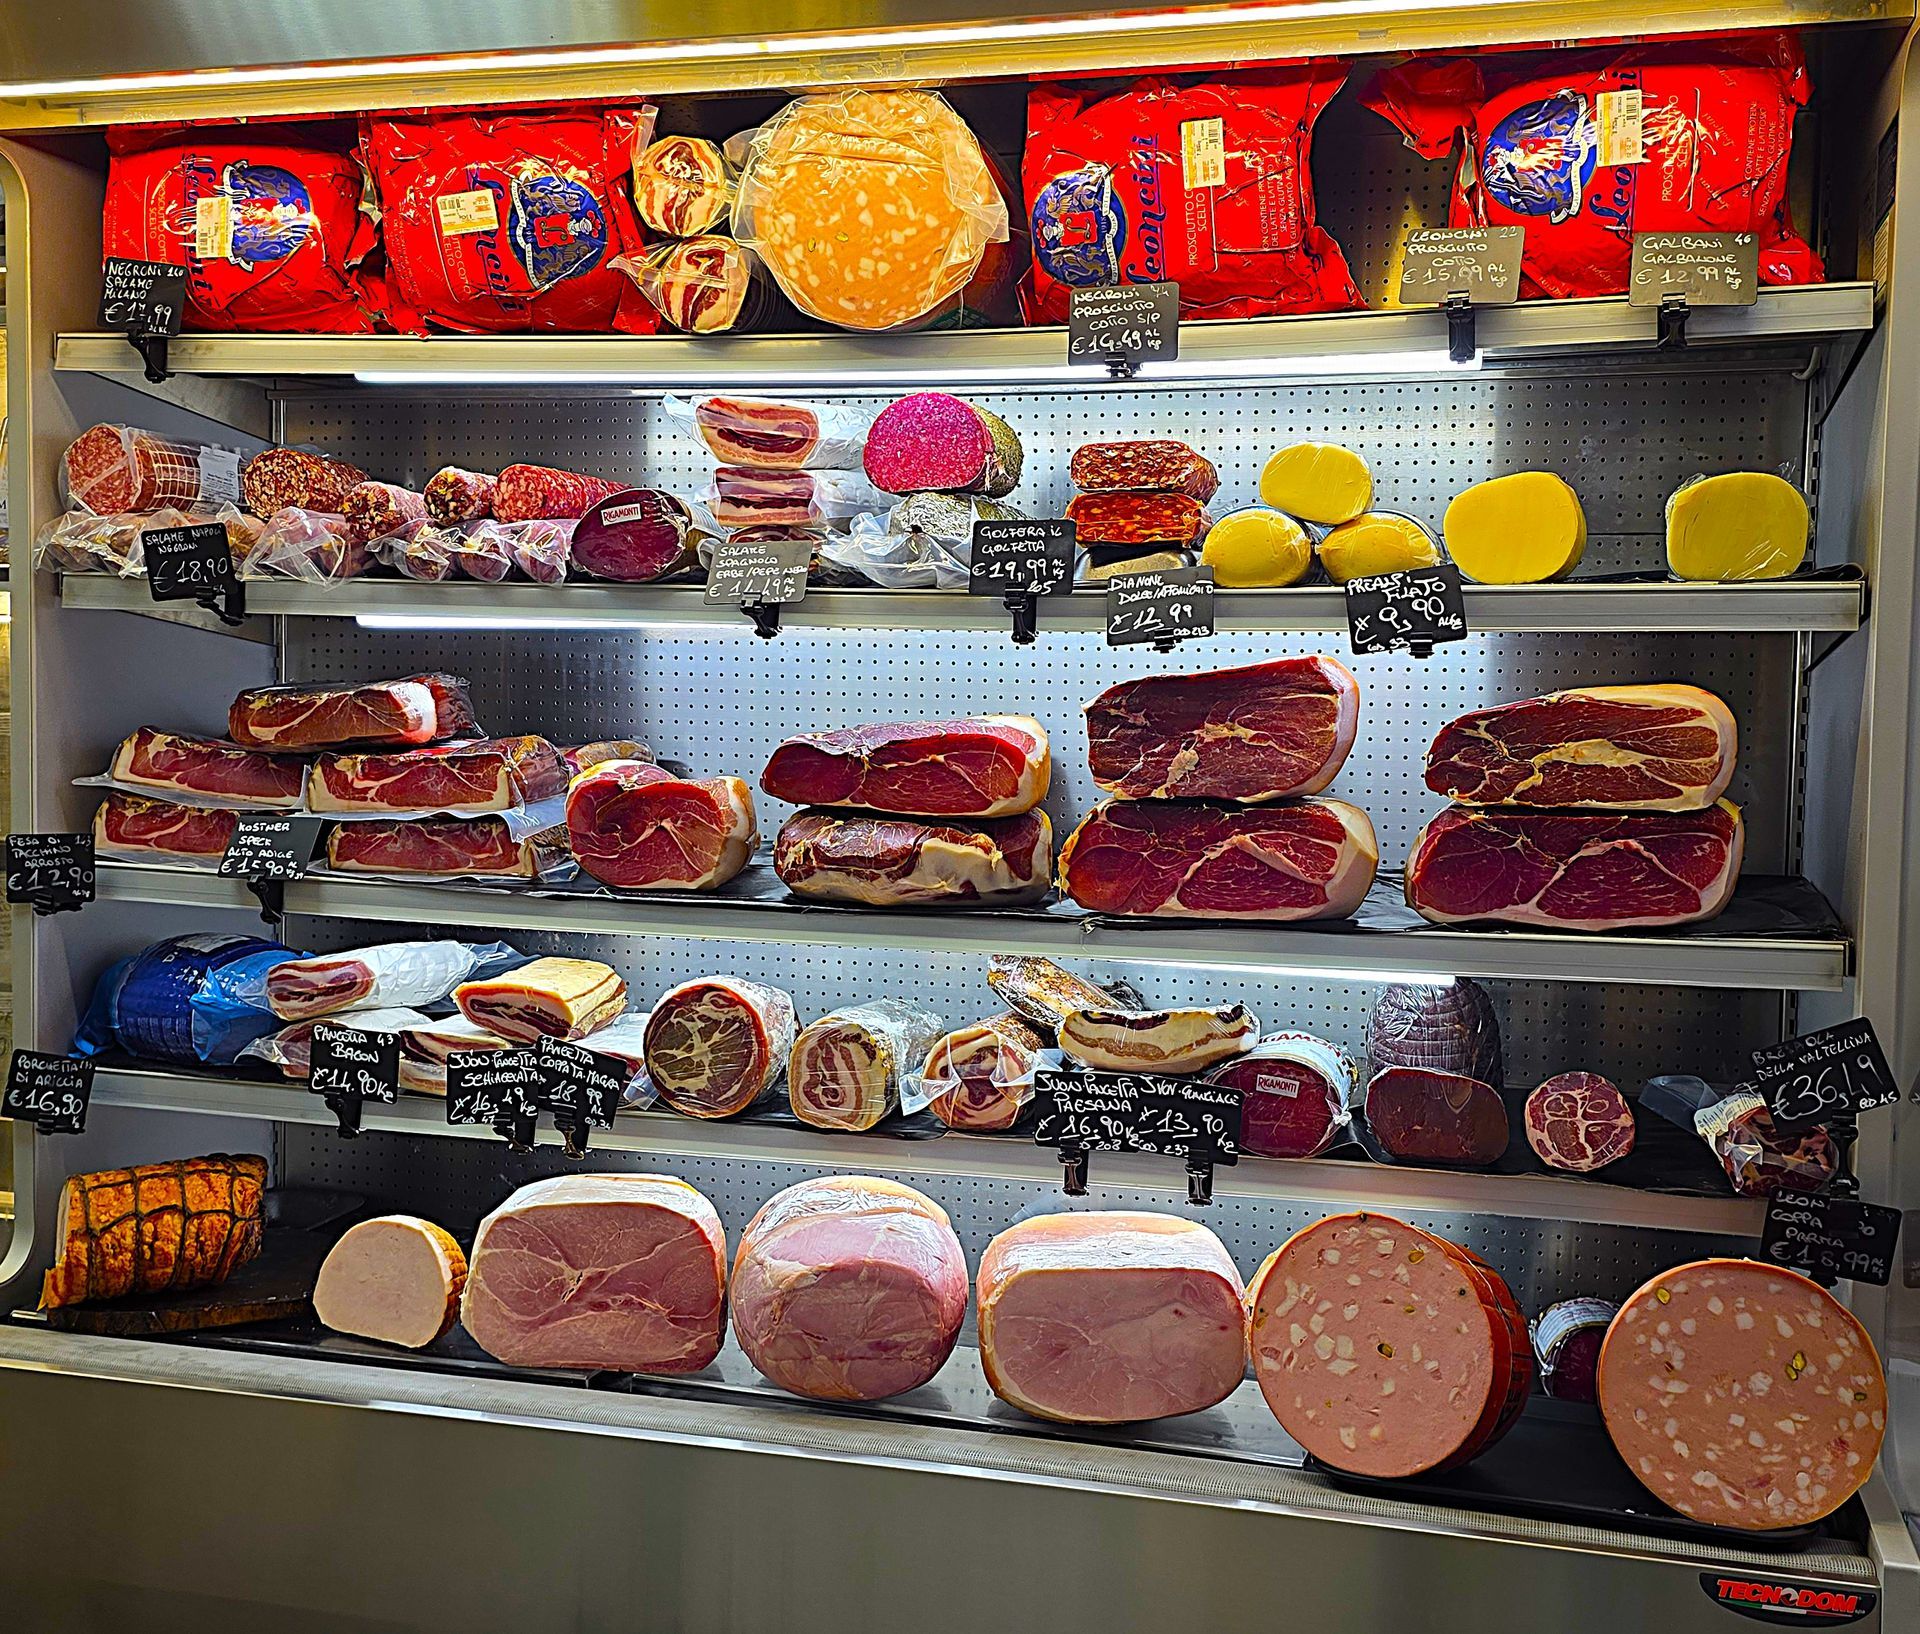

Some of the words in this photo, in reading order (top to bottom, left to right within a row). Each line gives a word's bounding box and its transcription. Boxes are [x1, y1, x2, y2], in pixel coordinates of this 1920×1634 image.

[1126, 135, 1167, 285] Leoncini
[1198, 192, 1208, 232] SCELTO
[1188, 202, 1199, 267] PROSCIUTTO
[1734, 233, 1751, 246] 46
[442, 236, 456, 268] CELTO
[1407, 242, 1488, 256] PROSCIUTTO
[1431, 256, 1476, 267] COTTO
[105, 276, 154, 289] SALAME
[104, 287, 147, 300] MILANO
[1073, 299, 1154, 319] PROSCIUTTO
[1089, 315, 1128, 331] COTTO
[1137, 312, 1161, 325] S/P
[603, 506, 639, 522] RIGAMONTI
[145, 531, 184, 546] SALAME
[981, 539, 1046, 557] GOLFETTA
[238, 822, 290, 832] KOSTNER
[9, 835, 40, 847] FESA
[238, 835, 272, 846] SPECK
[11, 845, 71, 858] TACCHINO
[227, 846, 254, 857] ALTO
[258, 850, 294, 858] ADIGE
[24, 858, 74, 869] ARROSTO
[377, 1034, 394, 1046] 43
[330, 1042, 379, 1064] BACON
[540, 1034, 595, 1065] PANCETTA
[1756, 1061, 1794, 1081] DELLA
[1799, 1032, 1872, 1065] VALTELLINA
[17, 1055, 79, 1073] PORCHETTA
[1258, 1076, 1297, 1094] RIGAMONTI
[1053, 1092, 1132, 1113] PAESANA
[1770, 1208, 1823, 1229] COPPA
[1785, 1226, 1844, 1248] PARMA
[1716, 1578, 1859, 1613] TECNODOM
